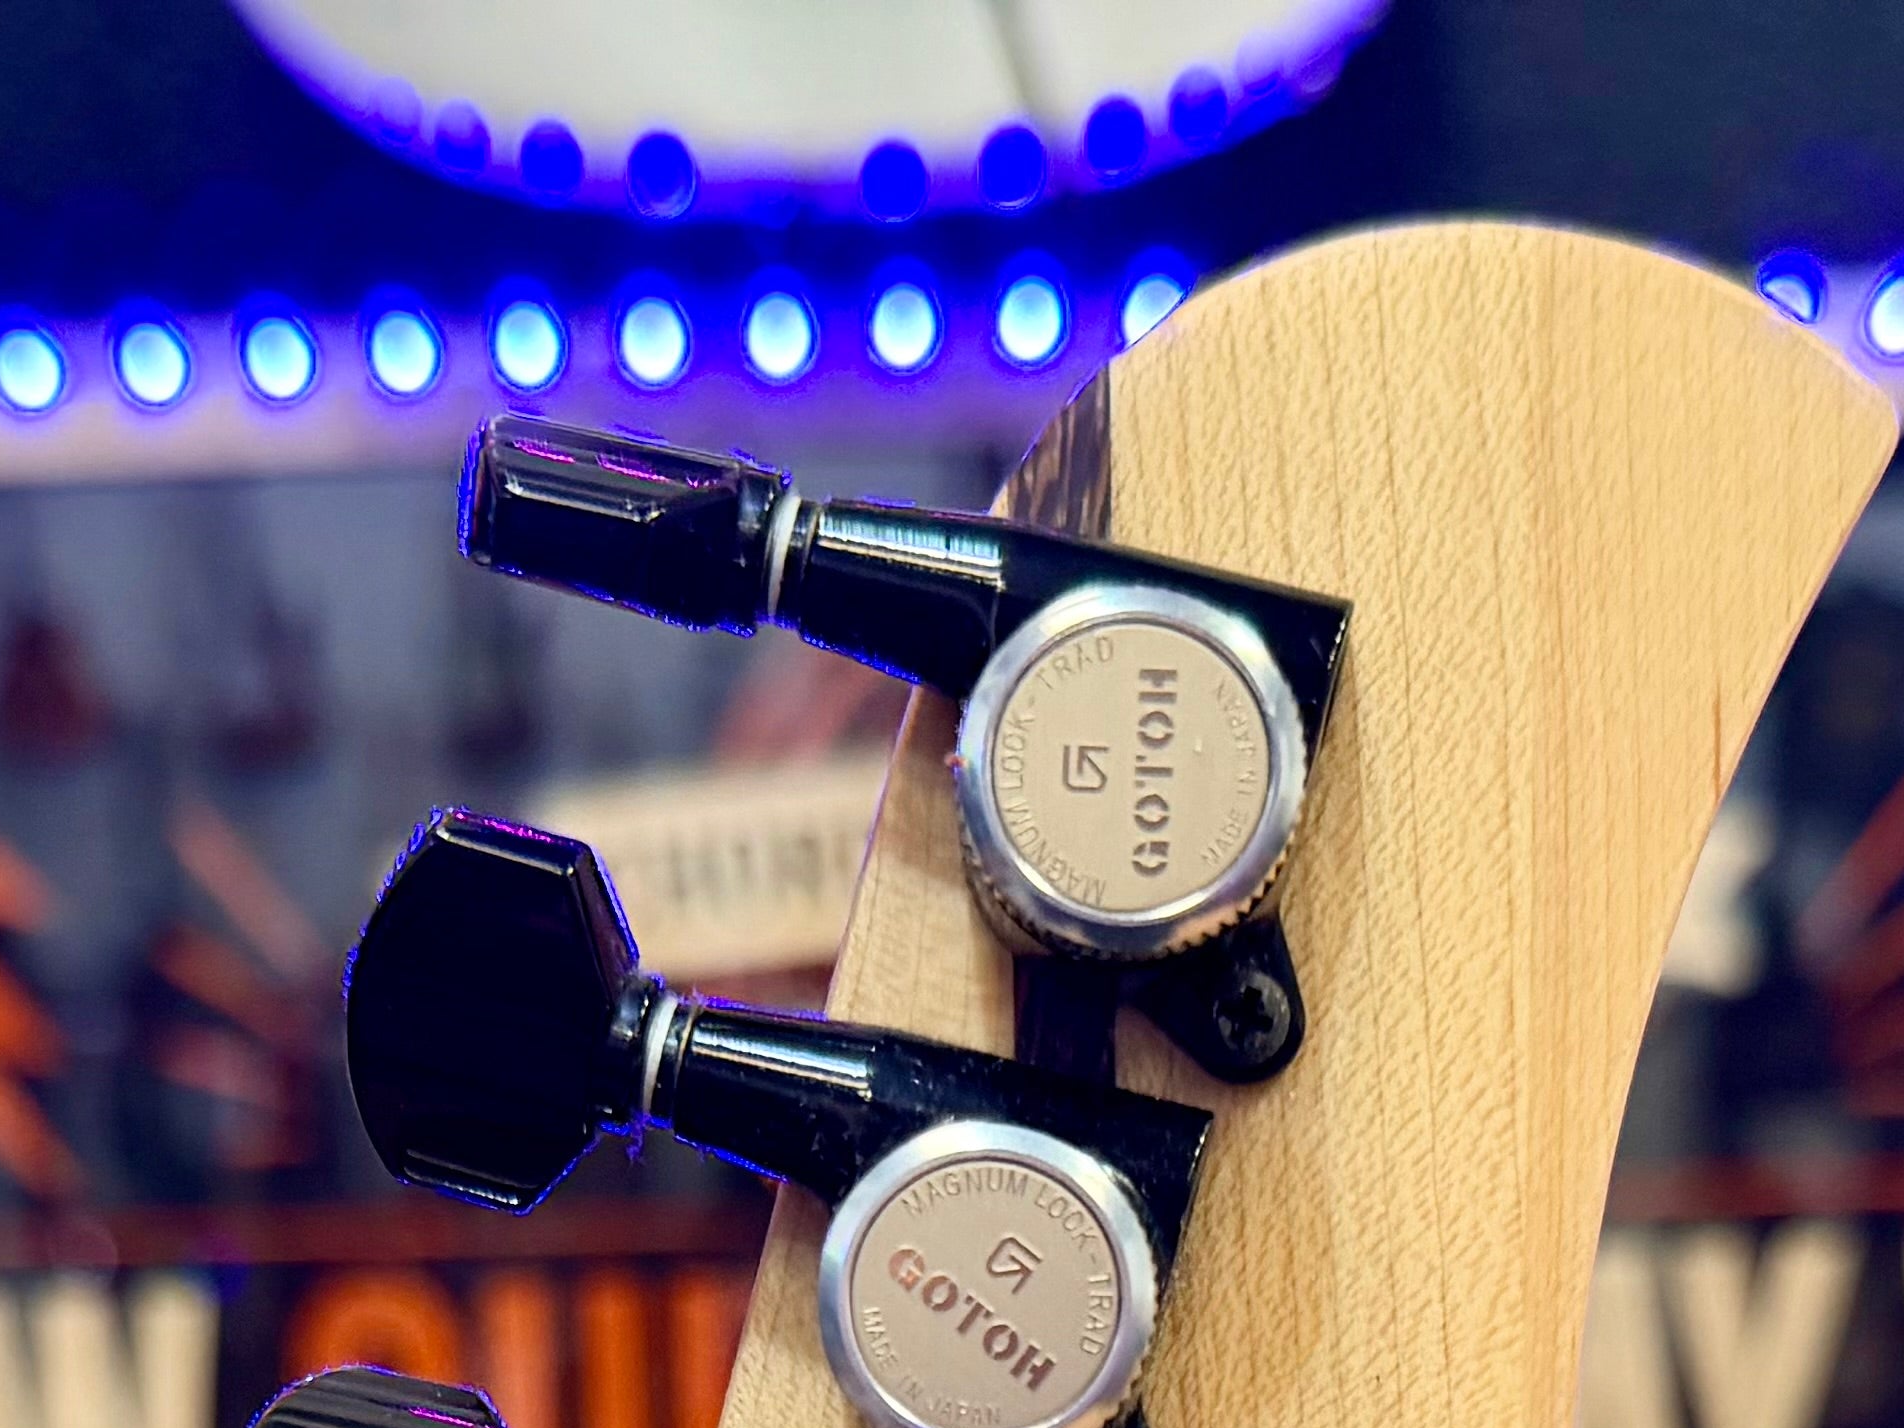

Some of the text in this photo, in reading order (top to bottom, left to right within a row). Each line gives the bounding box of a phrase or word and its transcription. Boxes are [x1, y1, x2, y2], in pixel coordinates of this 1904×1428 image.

[1132, 668, 1178, 877] GOTOH
[1201, 811, 1250, 868] MADE
[1235, 770, 1256, 795] IN
[1004, 804, 1106, 907] MAGNUM
[901, 1167, 1027, 1218] MAGNUM
[862, 1306, 896, 1366] MADE
[888, 1247, 1058, 1391] GOTOH
